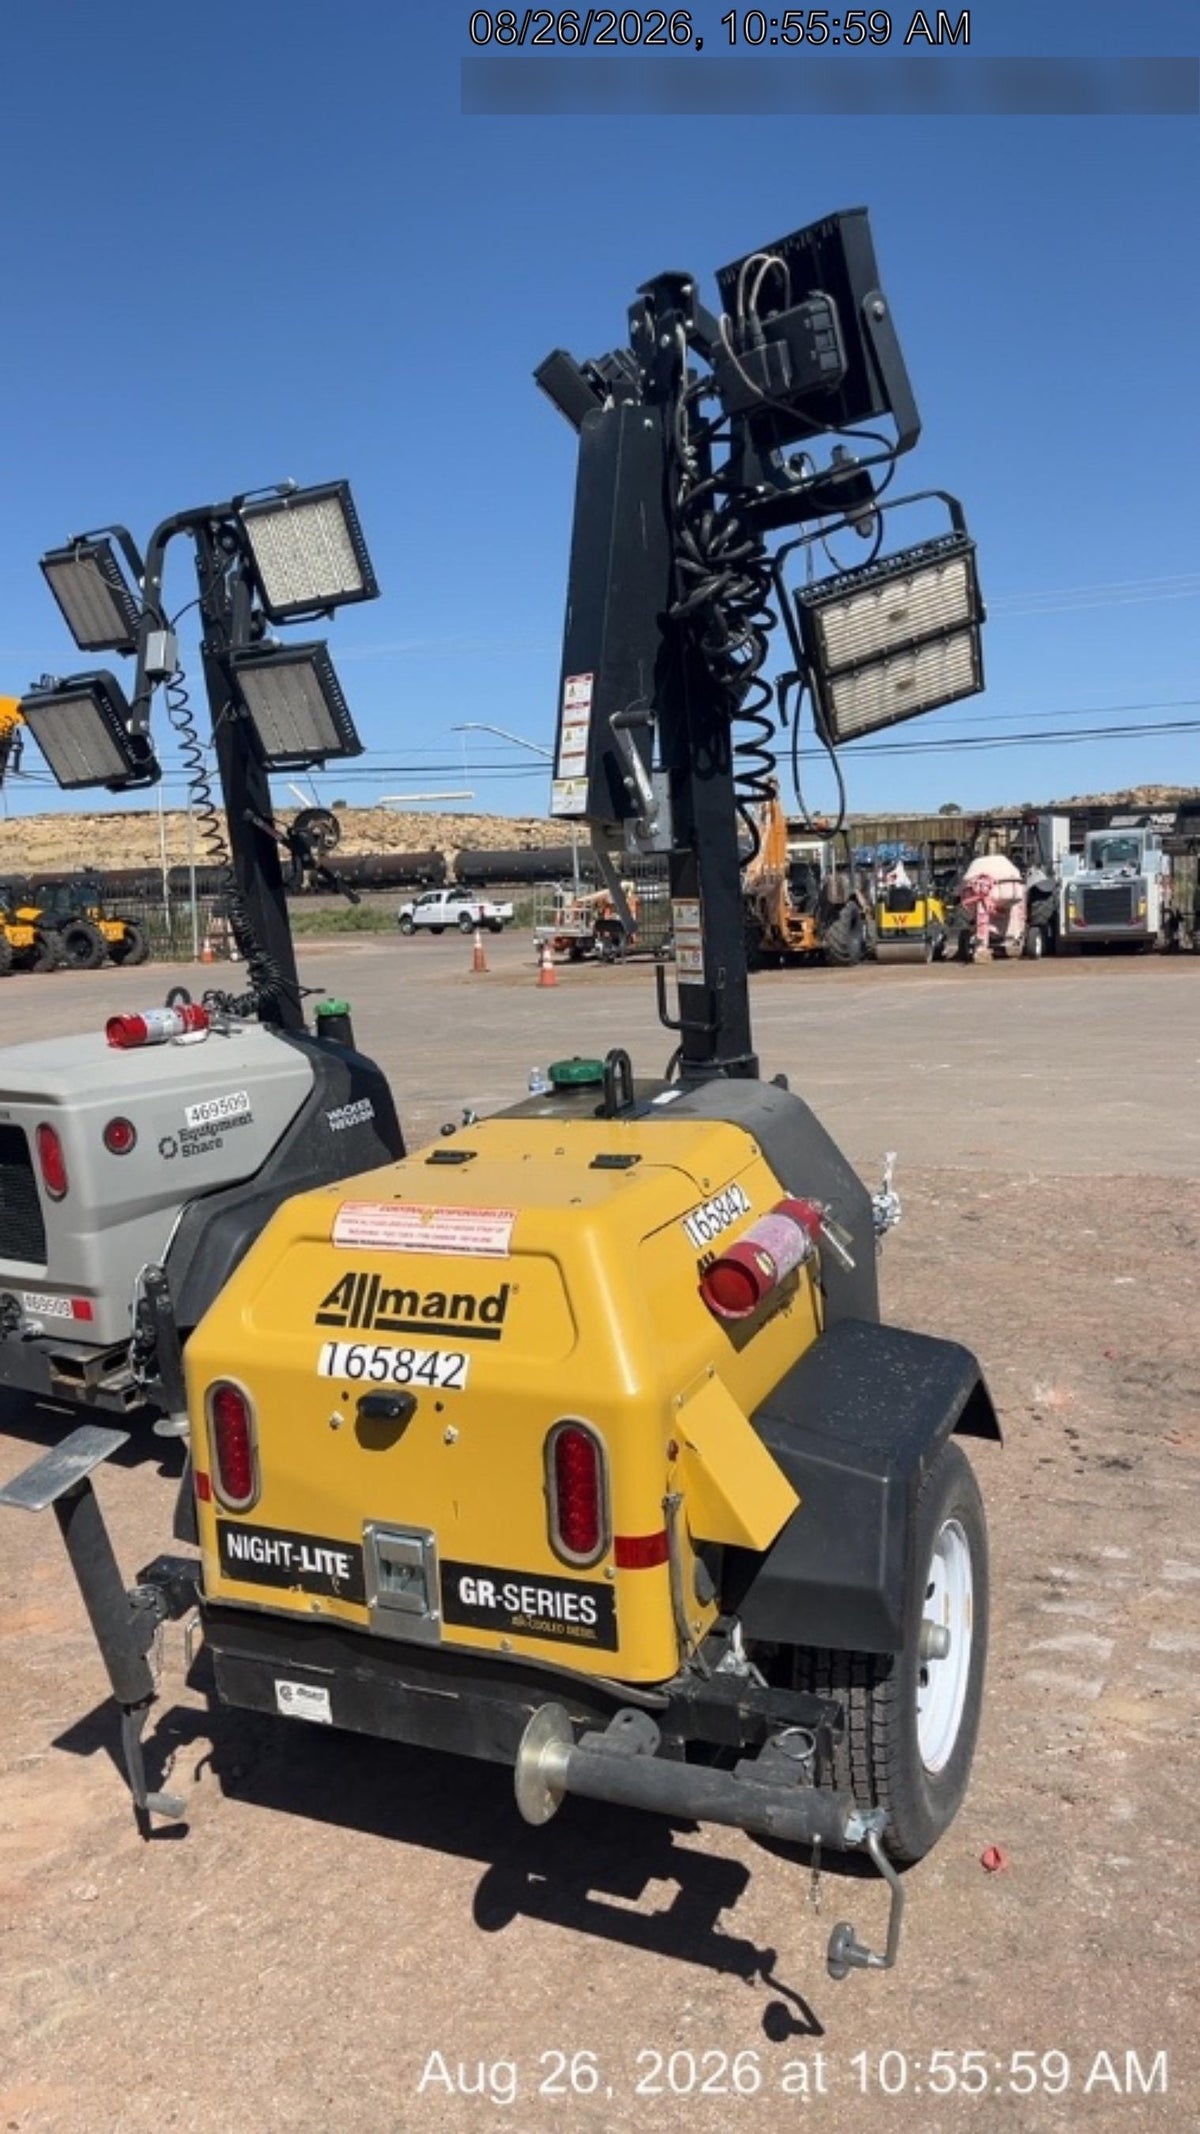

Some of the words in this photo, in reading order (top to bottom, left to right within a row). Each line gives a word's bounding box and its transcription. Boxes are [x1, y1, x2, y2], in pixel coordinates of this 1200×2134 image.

[178, 1112, 253, 1141] Equipment
[191, 1095, 248, 1123] 469509
[181, 1136, 223, 1158] Share
[683, 1183, 751, 1249] 165842
[318, 1272, 510, 1331] Allmand
[326, 1341, 466, 1391] 165842
[226, 1532, 350, 1580] NIGHT-LITE
[458, 1576, 597, 1625] GR-SERIES
